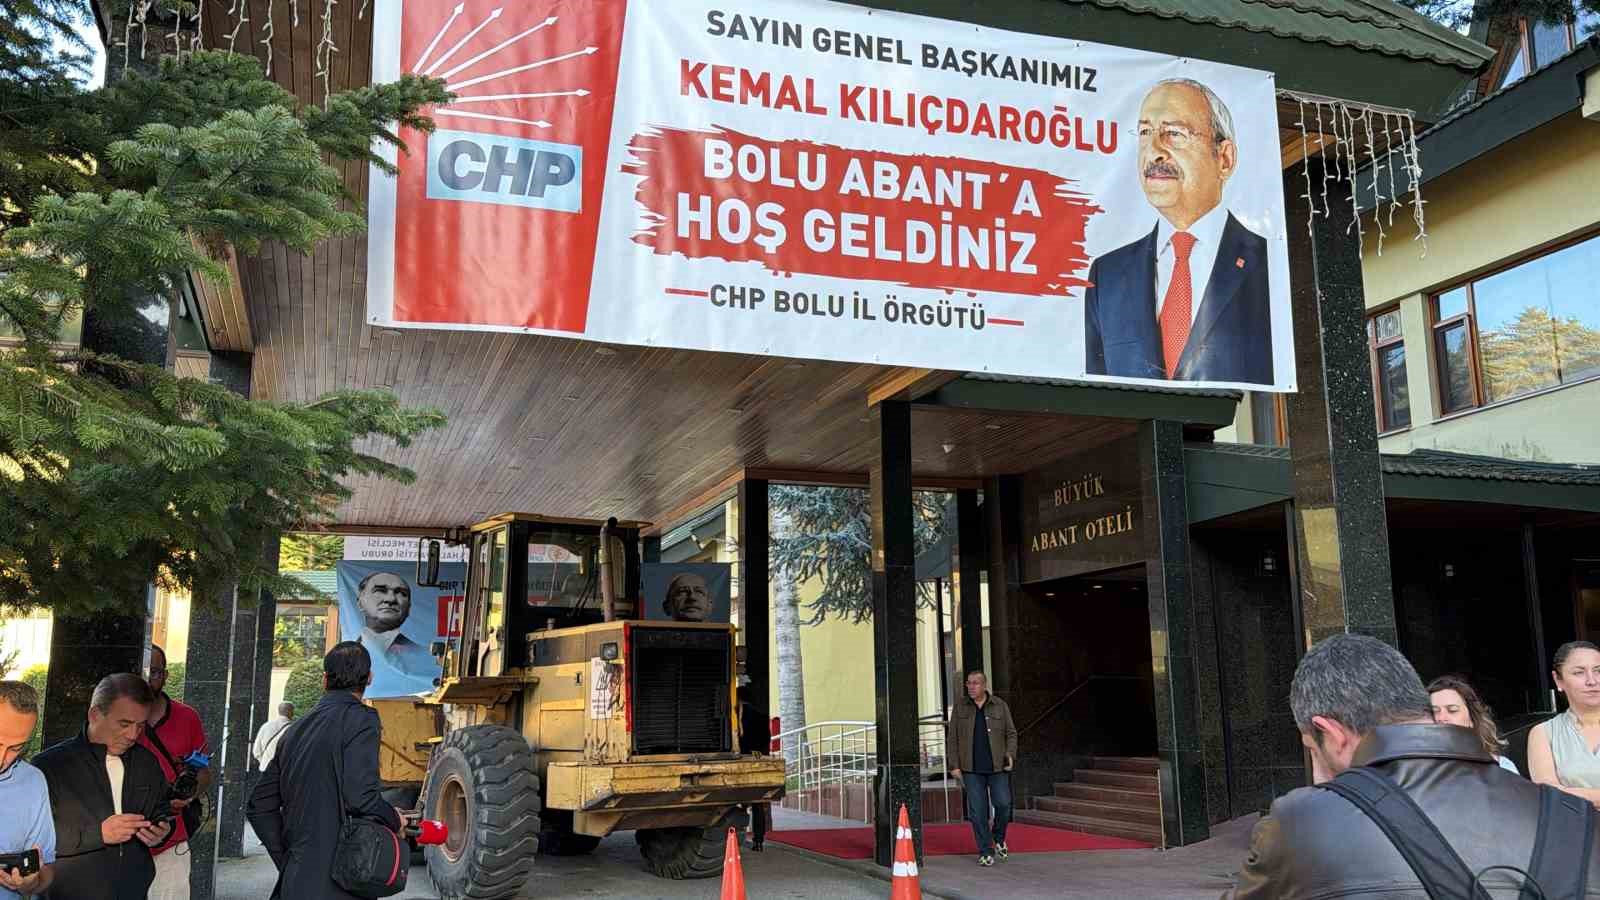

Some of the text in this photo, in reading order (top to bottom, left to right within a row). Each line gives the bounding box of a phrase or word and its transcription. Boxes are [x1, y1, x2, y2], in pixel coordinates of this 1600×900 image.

[706, 10, 1098, 93] SAYIN GENEL BAŞKANIMIZ
[680, 58, 1118, 155] KEMAL KILIÇDAROĞLU
[438, 139, 576, 198] CHP
[703, 138, 827, 191] BOLU
[677, 192, 1039, 276] HOŞ GELDİNİZ
[709, 284, 986, 331] CHP BOLU İL ÖRGÜTÜ
[1054, 472, 1105, 507] BÜYÜK
[1031, 505, 1134, 553] ABANT OTELİ
